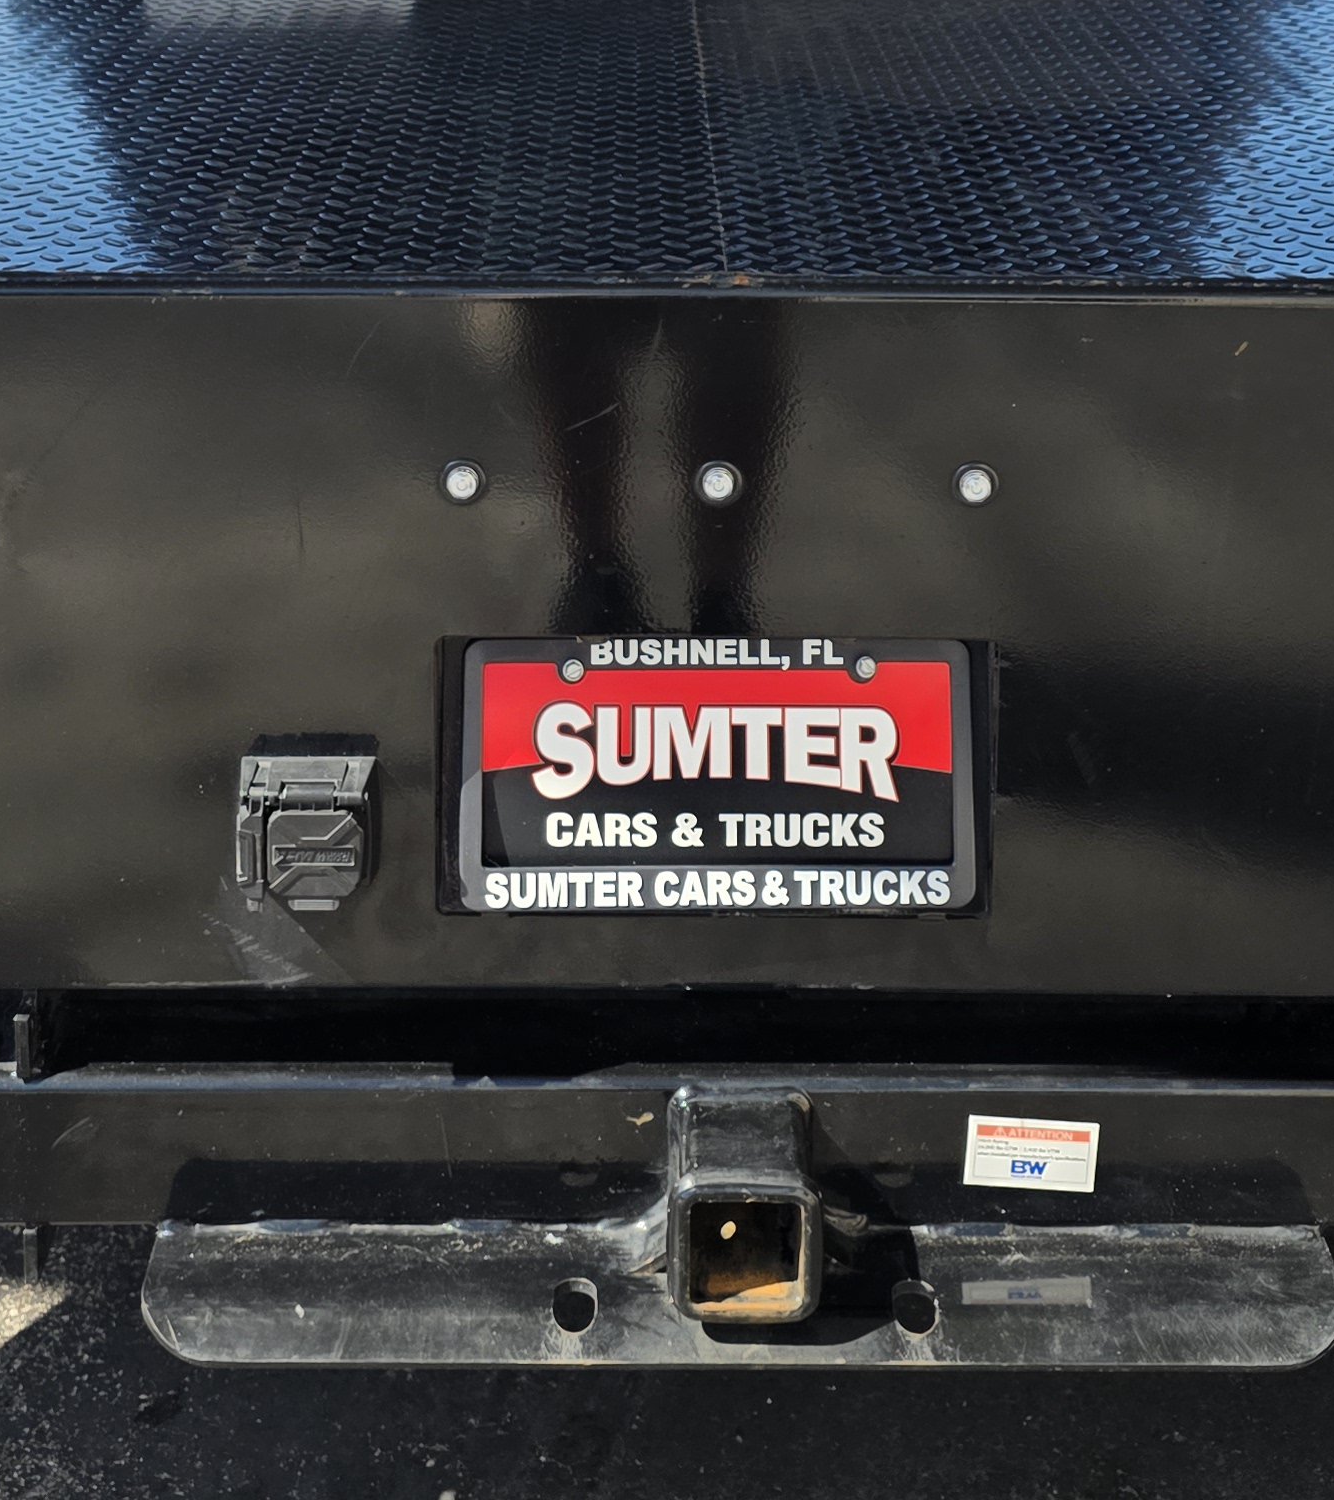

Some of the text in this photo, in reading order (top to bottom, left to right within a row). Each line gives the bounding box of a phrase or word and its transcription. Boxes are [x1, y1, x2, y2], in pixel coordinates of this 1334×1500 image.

[590, 638, 844, 670] BUSHNELL, FL
[531, 701, 900, 802] SUMTER
[546, 812, 885, 848] CARS & TRUCKS
[485, 870, 952, 910] SUMTER CARS & TRUCKS
[1008, 1127, 1074, 1141] ATTENTION
